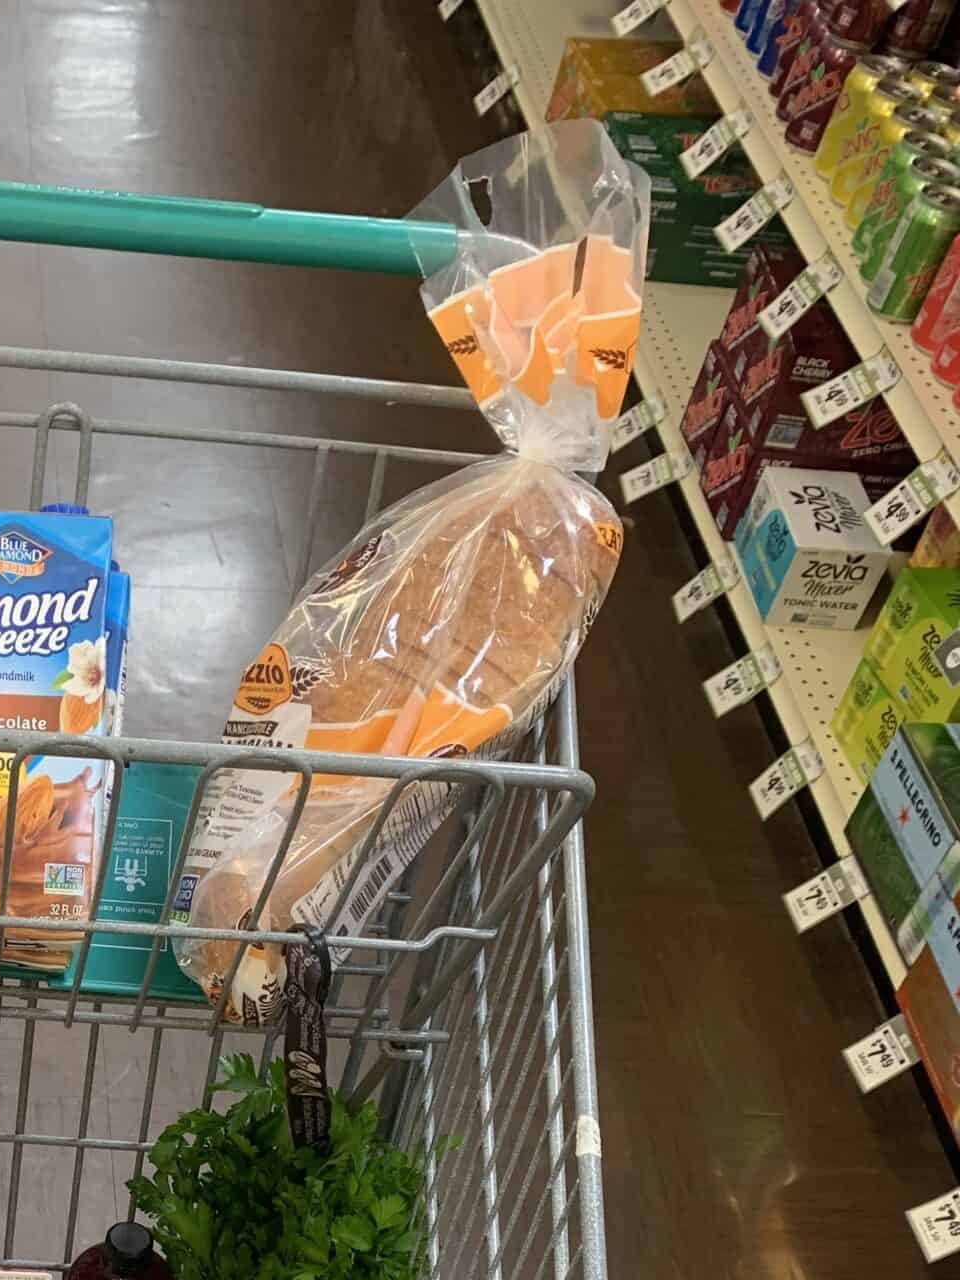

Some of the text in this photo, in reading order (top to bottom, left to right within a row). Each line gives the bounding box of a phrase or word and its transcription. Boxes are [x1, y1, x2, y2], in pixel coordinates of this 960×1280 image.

[796, 356, 831, 368] BLACK
[792, 366, 833, 379] CHERRY
[0, 536, 28, 552] BLUE
[783, 598, 859, 611] TONIC WATER
[889, 748, 942, 848] S.PELLEGRINO
[867, 1039, 895, 1068] $749
